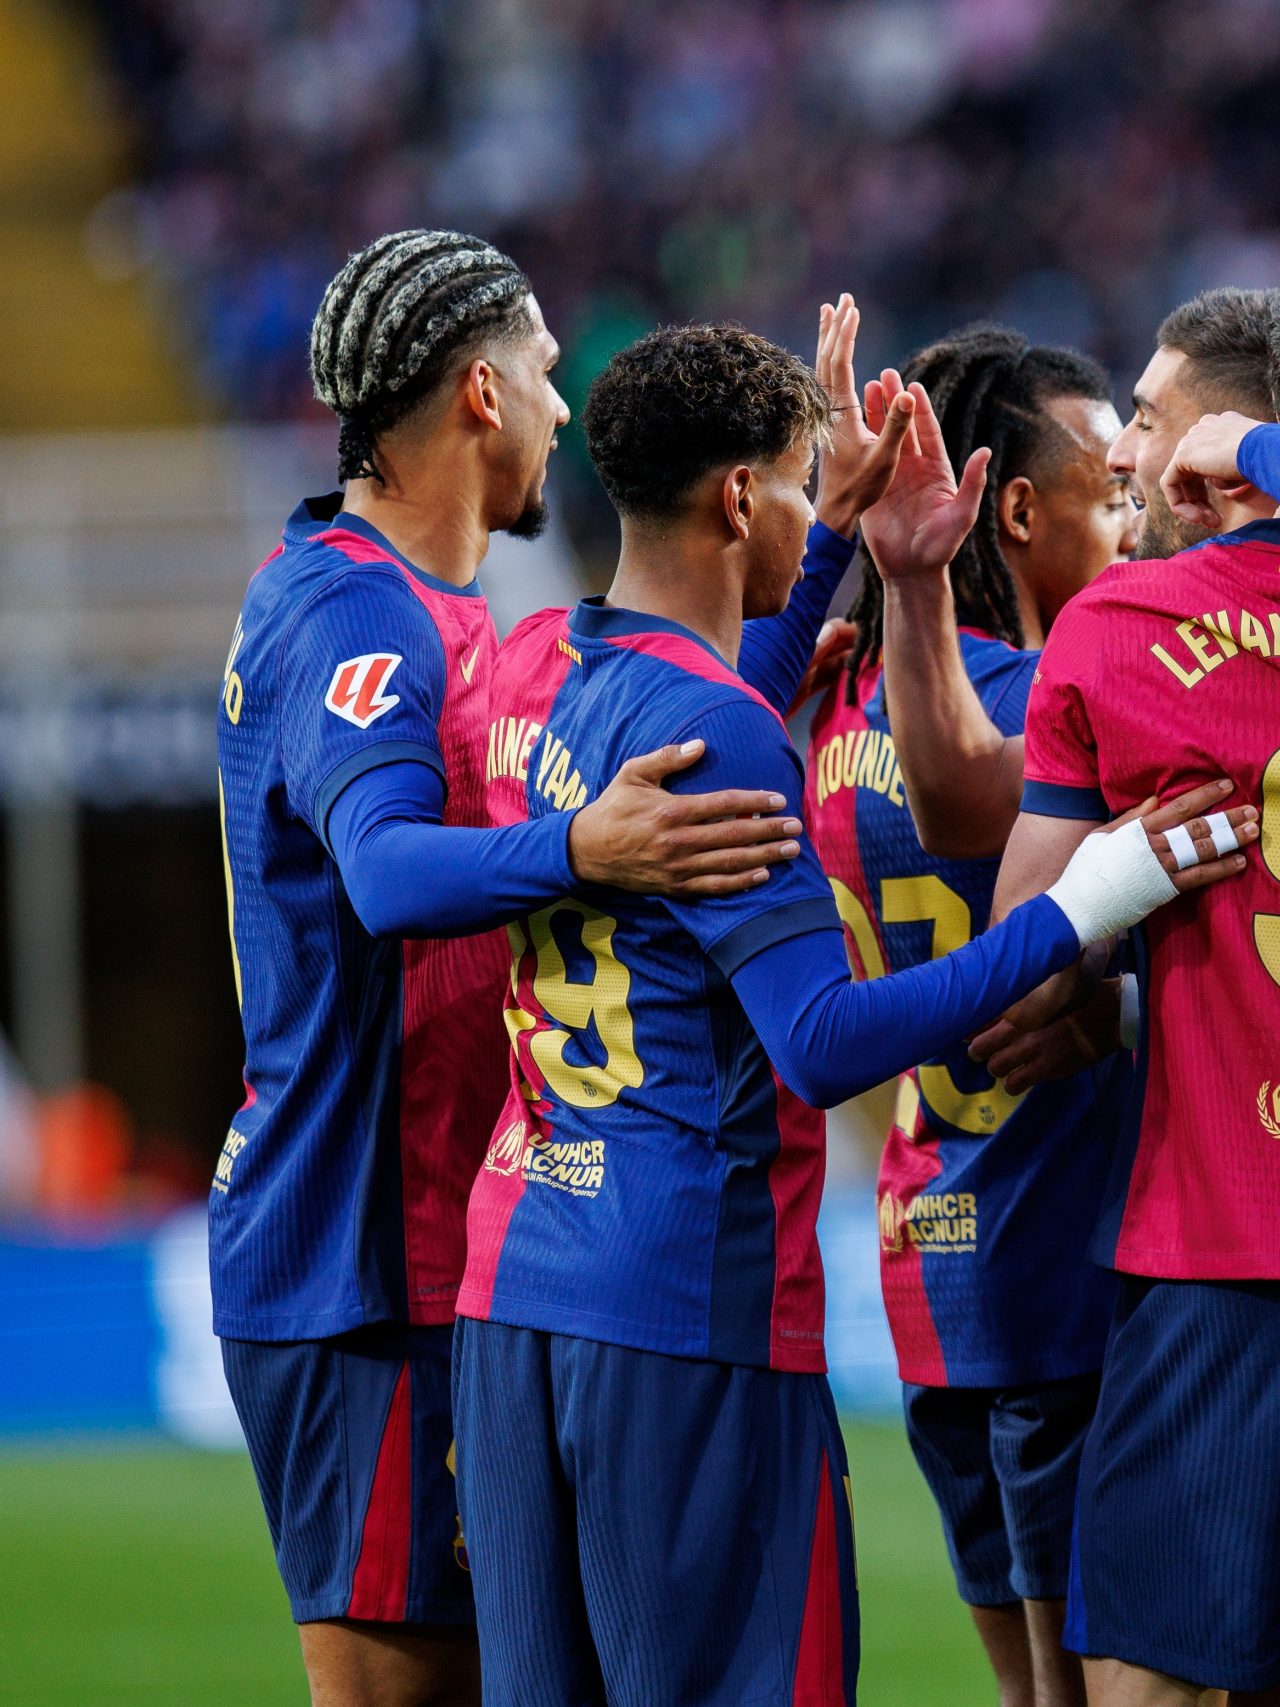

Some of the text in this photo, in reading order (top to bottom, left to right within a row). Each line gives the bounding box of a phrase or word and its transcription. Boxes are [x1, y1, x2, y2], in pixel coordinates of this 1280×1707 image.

[527, 1132, 605, 1165] UNHCR
[521, 1146, 605, 1188] ACNUR
[568, 1186, 599, 1199] Agency
[907, 1218, 977, 1243] ACNUR
